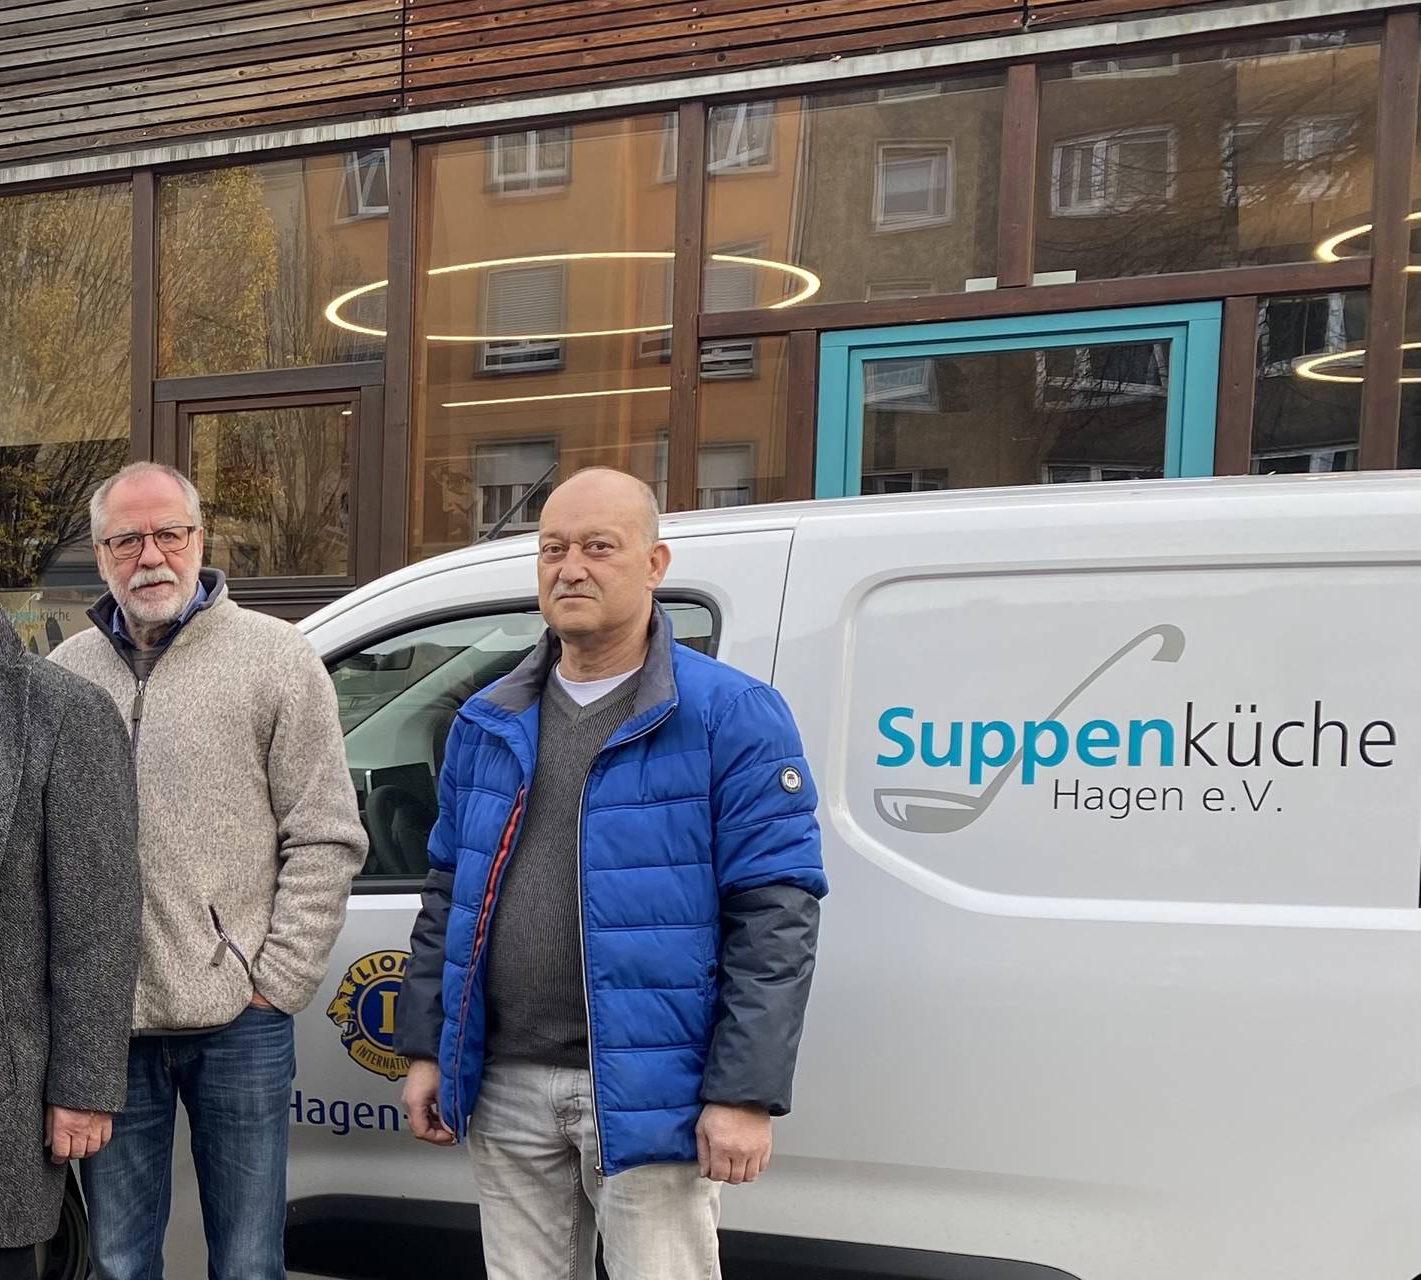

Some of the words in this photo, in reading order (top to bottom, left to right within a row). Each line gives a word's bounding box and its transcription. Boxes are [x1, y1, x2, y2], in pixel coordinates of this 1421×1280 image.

[876, 700, 1396, 785] Suppenküche
[1053, 779, 1183, 819] Hagen
[1202, 780, 1282, 812] e.V.
